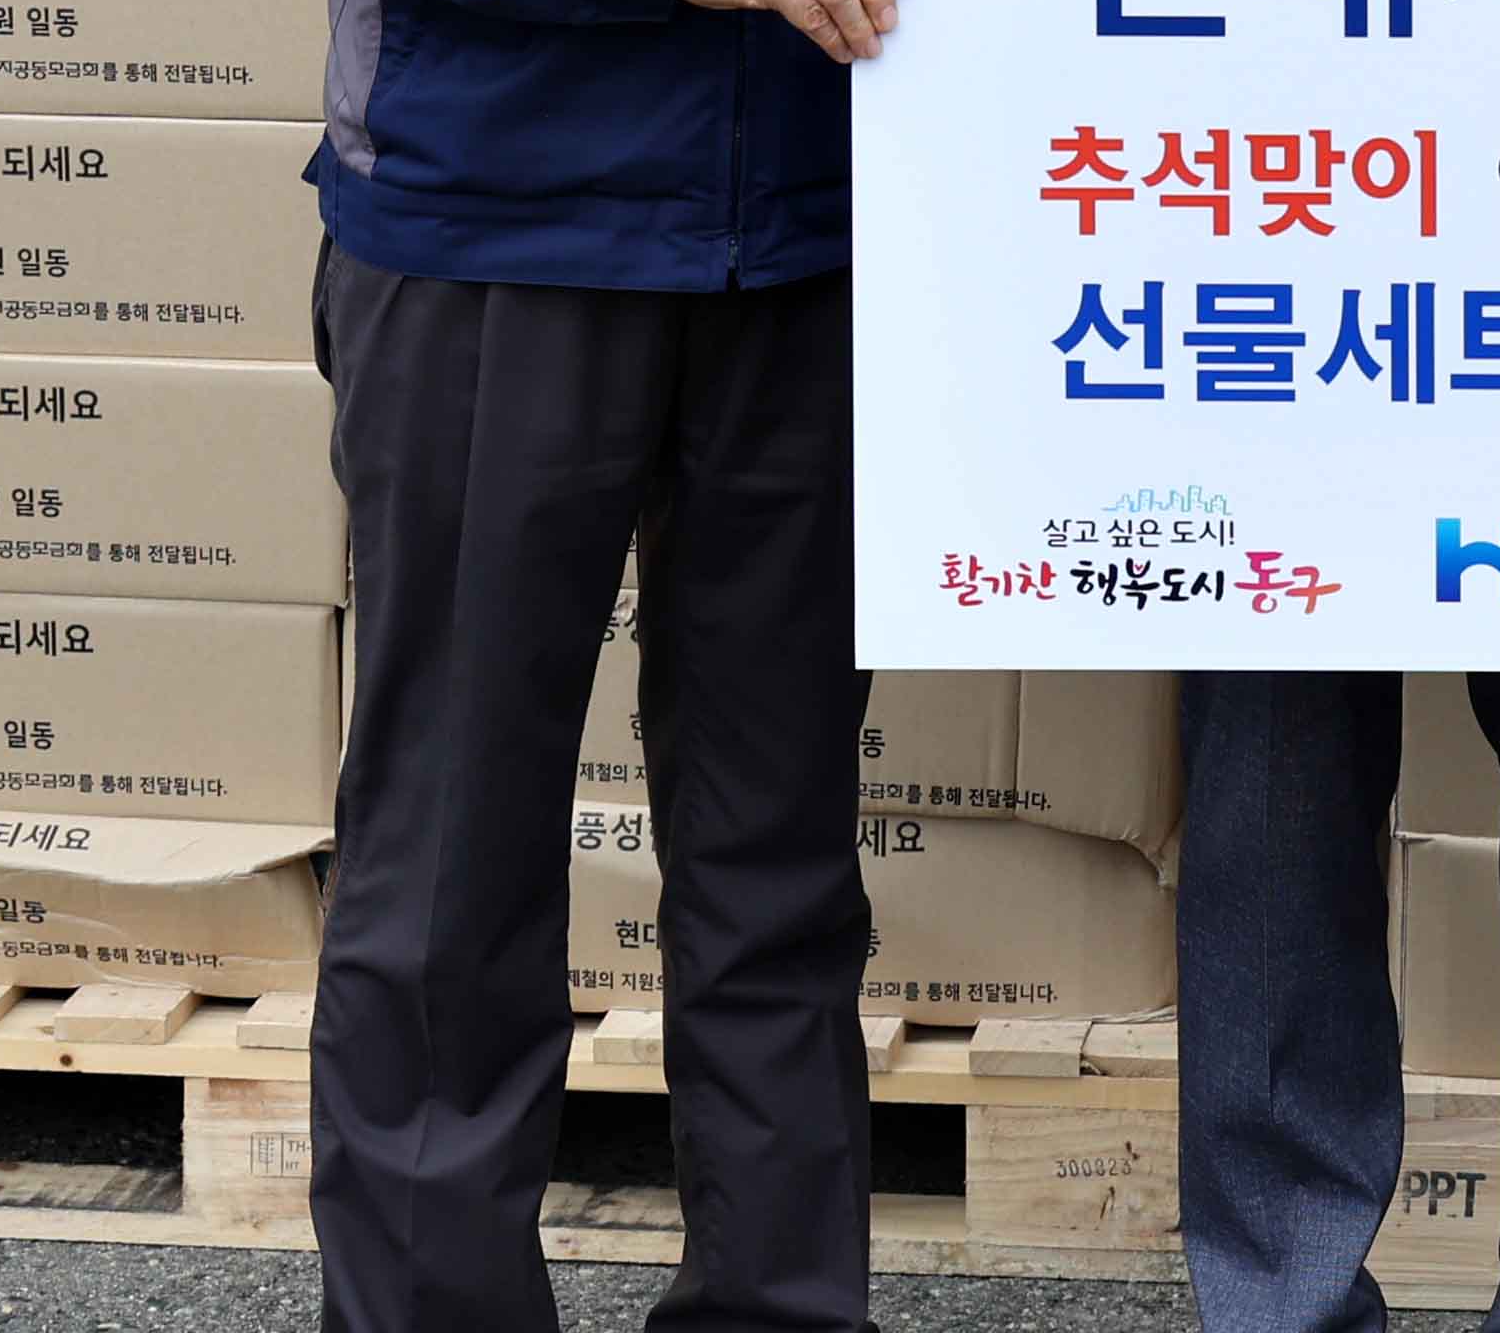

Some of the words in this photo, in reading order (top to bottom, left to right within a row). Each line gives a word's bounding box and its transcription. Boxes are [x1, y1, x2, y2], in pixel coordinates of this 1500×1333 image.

[26, 6, 79, 38] 일동
[123, 62, 158, 83] 통해
[164, 63, 253, 86] 전달됩니다.
[1039, 125, 1439, 238] 추석맞이
[1043, 519, 1099, 548] 살고
[1106, 519, 1162, 548] 싶은
[1170, 520, 1235, 547] 도시!
[939, 553, 1057, 607] 활기찬
[1070, 557, 1225, 611] 행복도시
[1233, 551, 1342, 614] 동구
[1403, 1171, 1487, 1218] PPT
